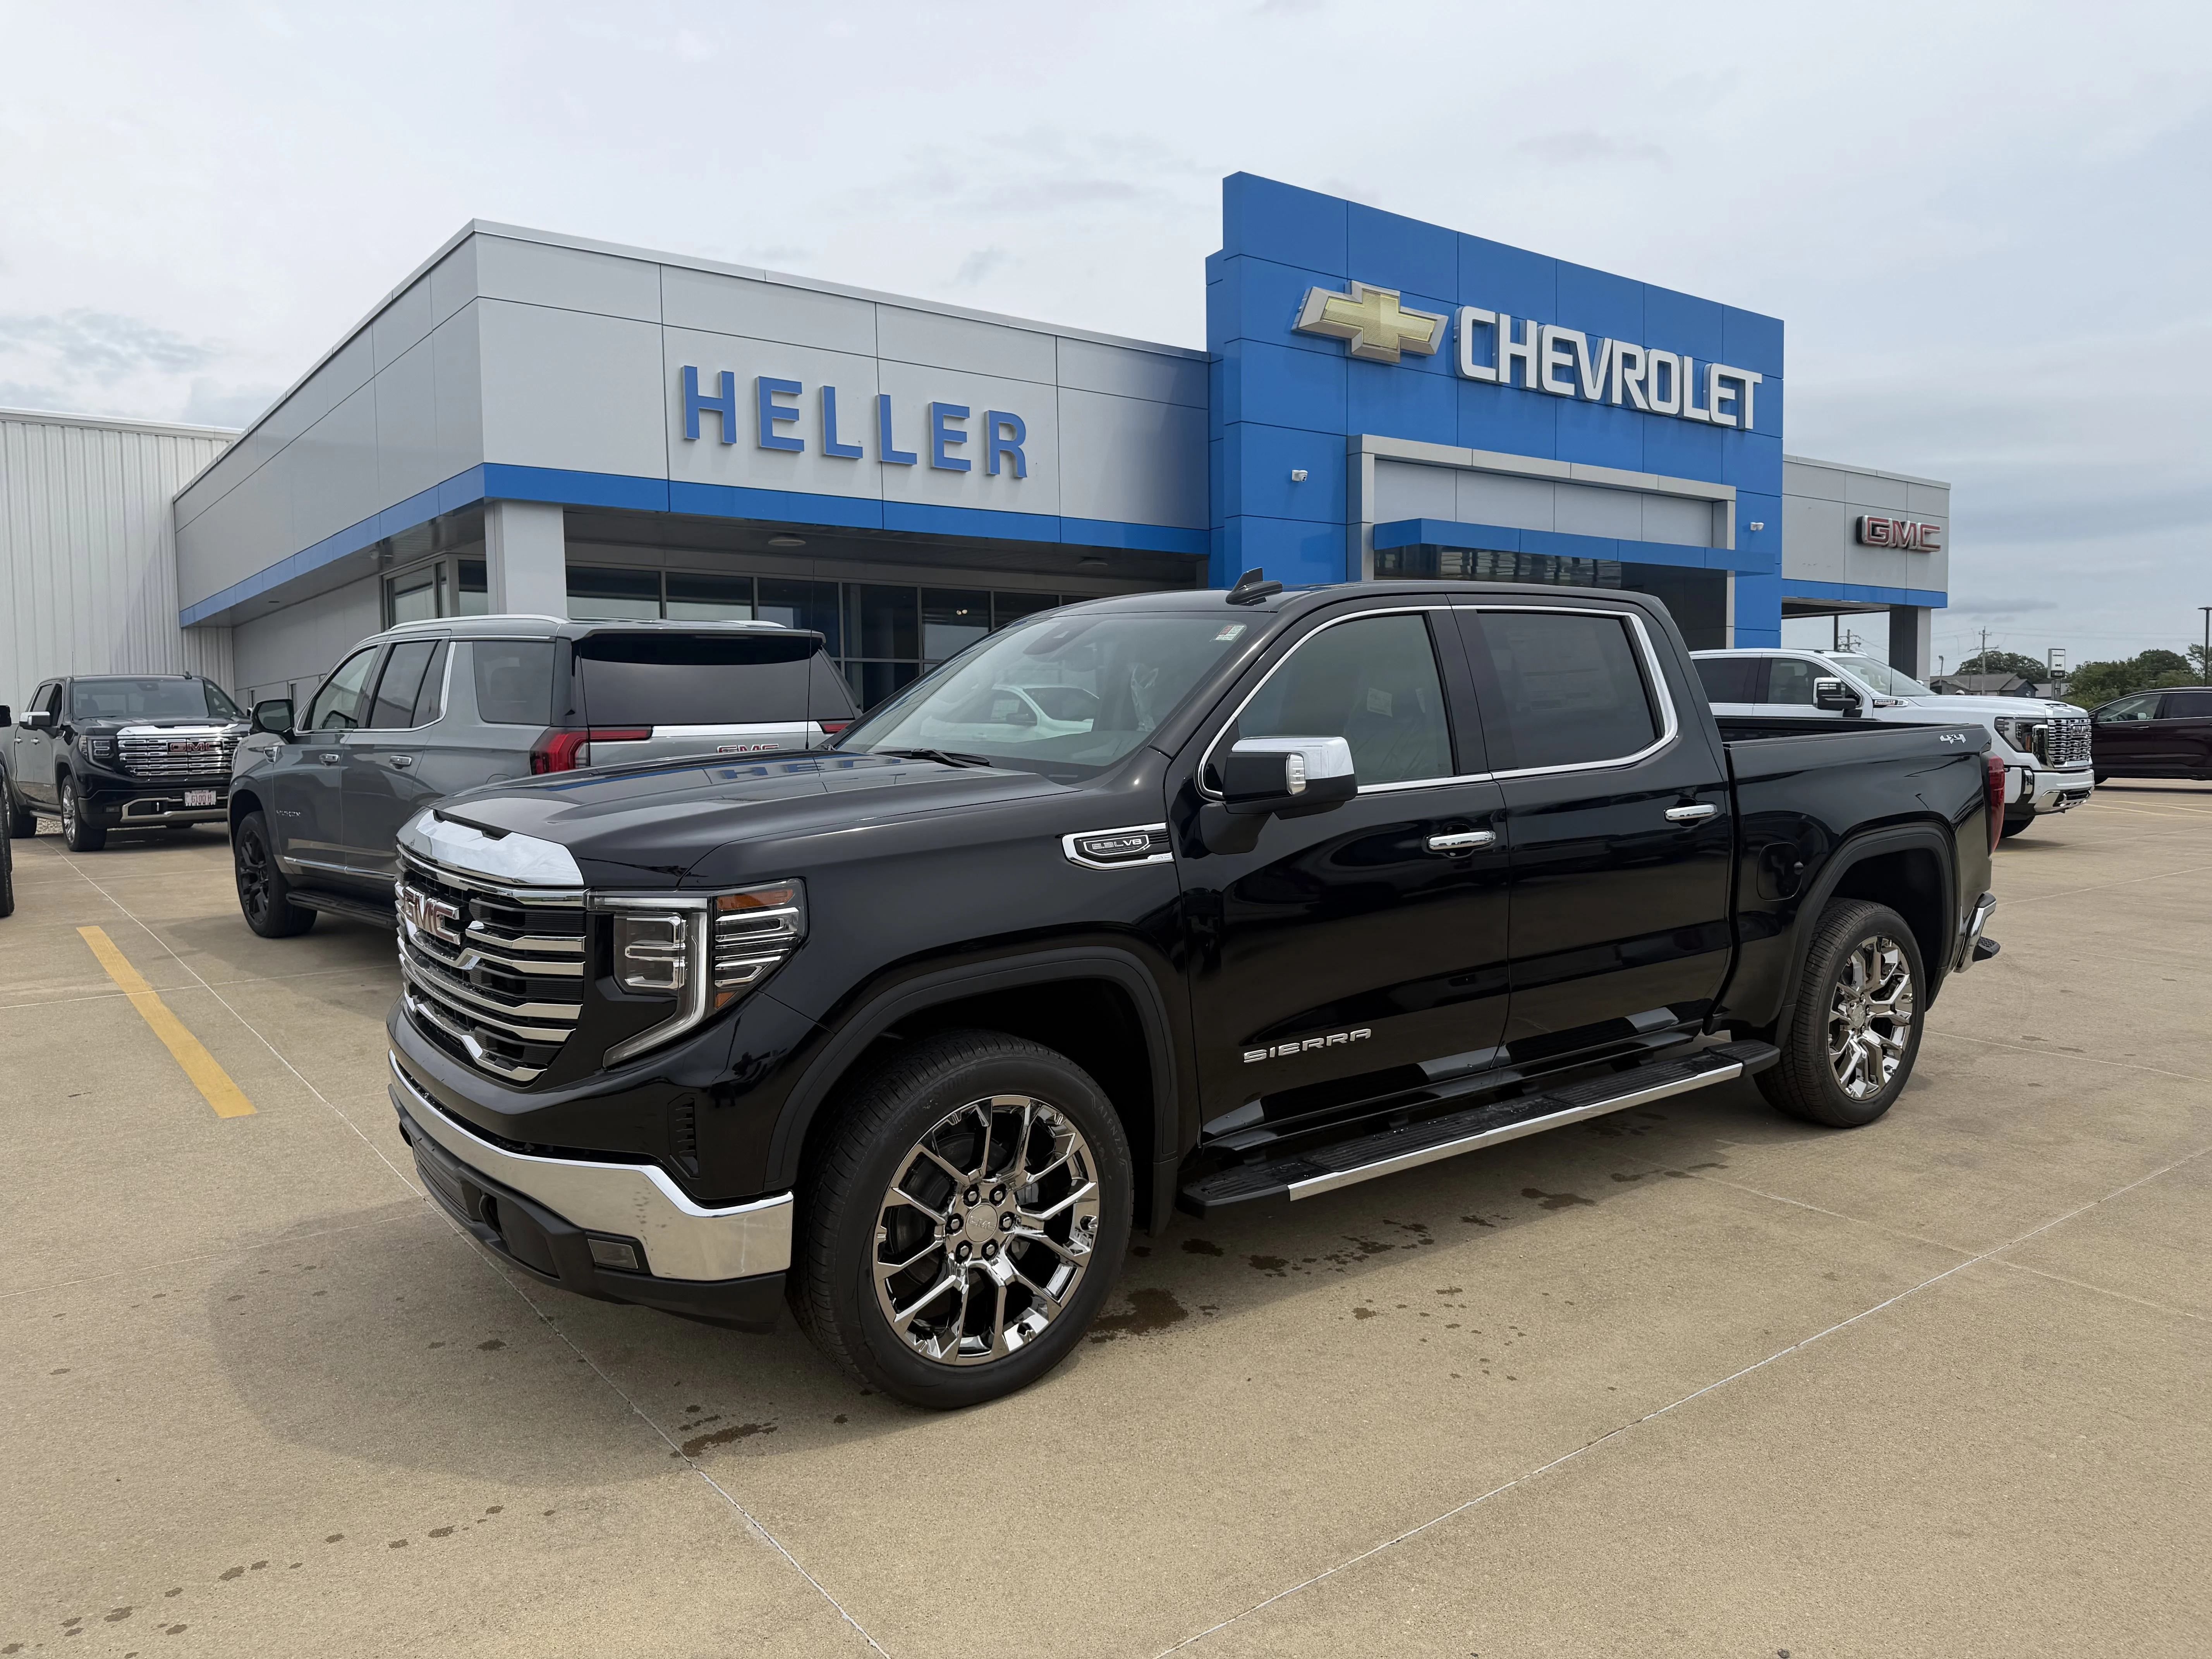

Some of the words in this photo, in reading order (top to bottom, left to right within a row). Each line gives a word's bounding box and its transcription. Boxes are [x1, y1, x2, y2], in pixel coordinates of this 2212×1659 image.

[1454, 305, 1762, 431] CHEVROLET
[680, 365, 1027, 479] HELLER
[1856, 515, 1941, 553] GMC
[170, 742, 222, 752] GMC
[404, 885, 461, 946] GMC
[1243, 1028, 1372, 1063] SIERRA
